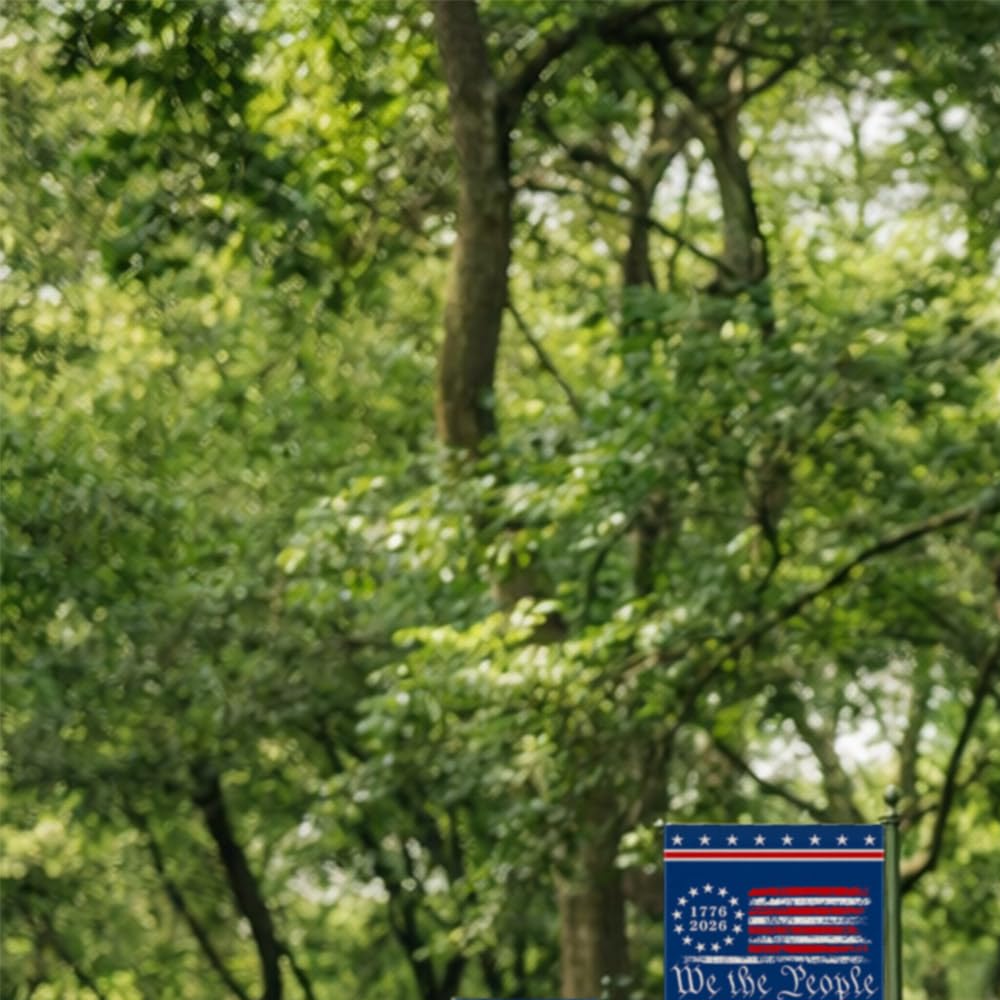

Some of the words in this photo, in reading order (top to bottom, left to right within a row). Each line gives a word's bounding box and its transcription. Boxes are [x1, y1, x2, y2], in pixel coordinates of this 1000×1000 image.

[690, 906, 727, 917] 1776
[689, 920, 727, 932] 2026
[672, 964, 721, 1000] We
[728, 965, 772, 1000] the
